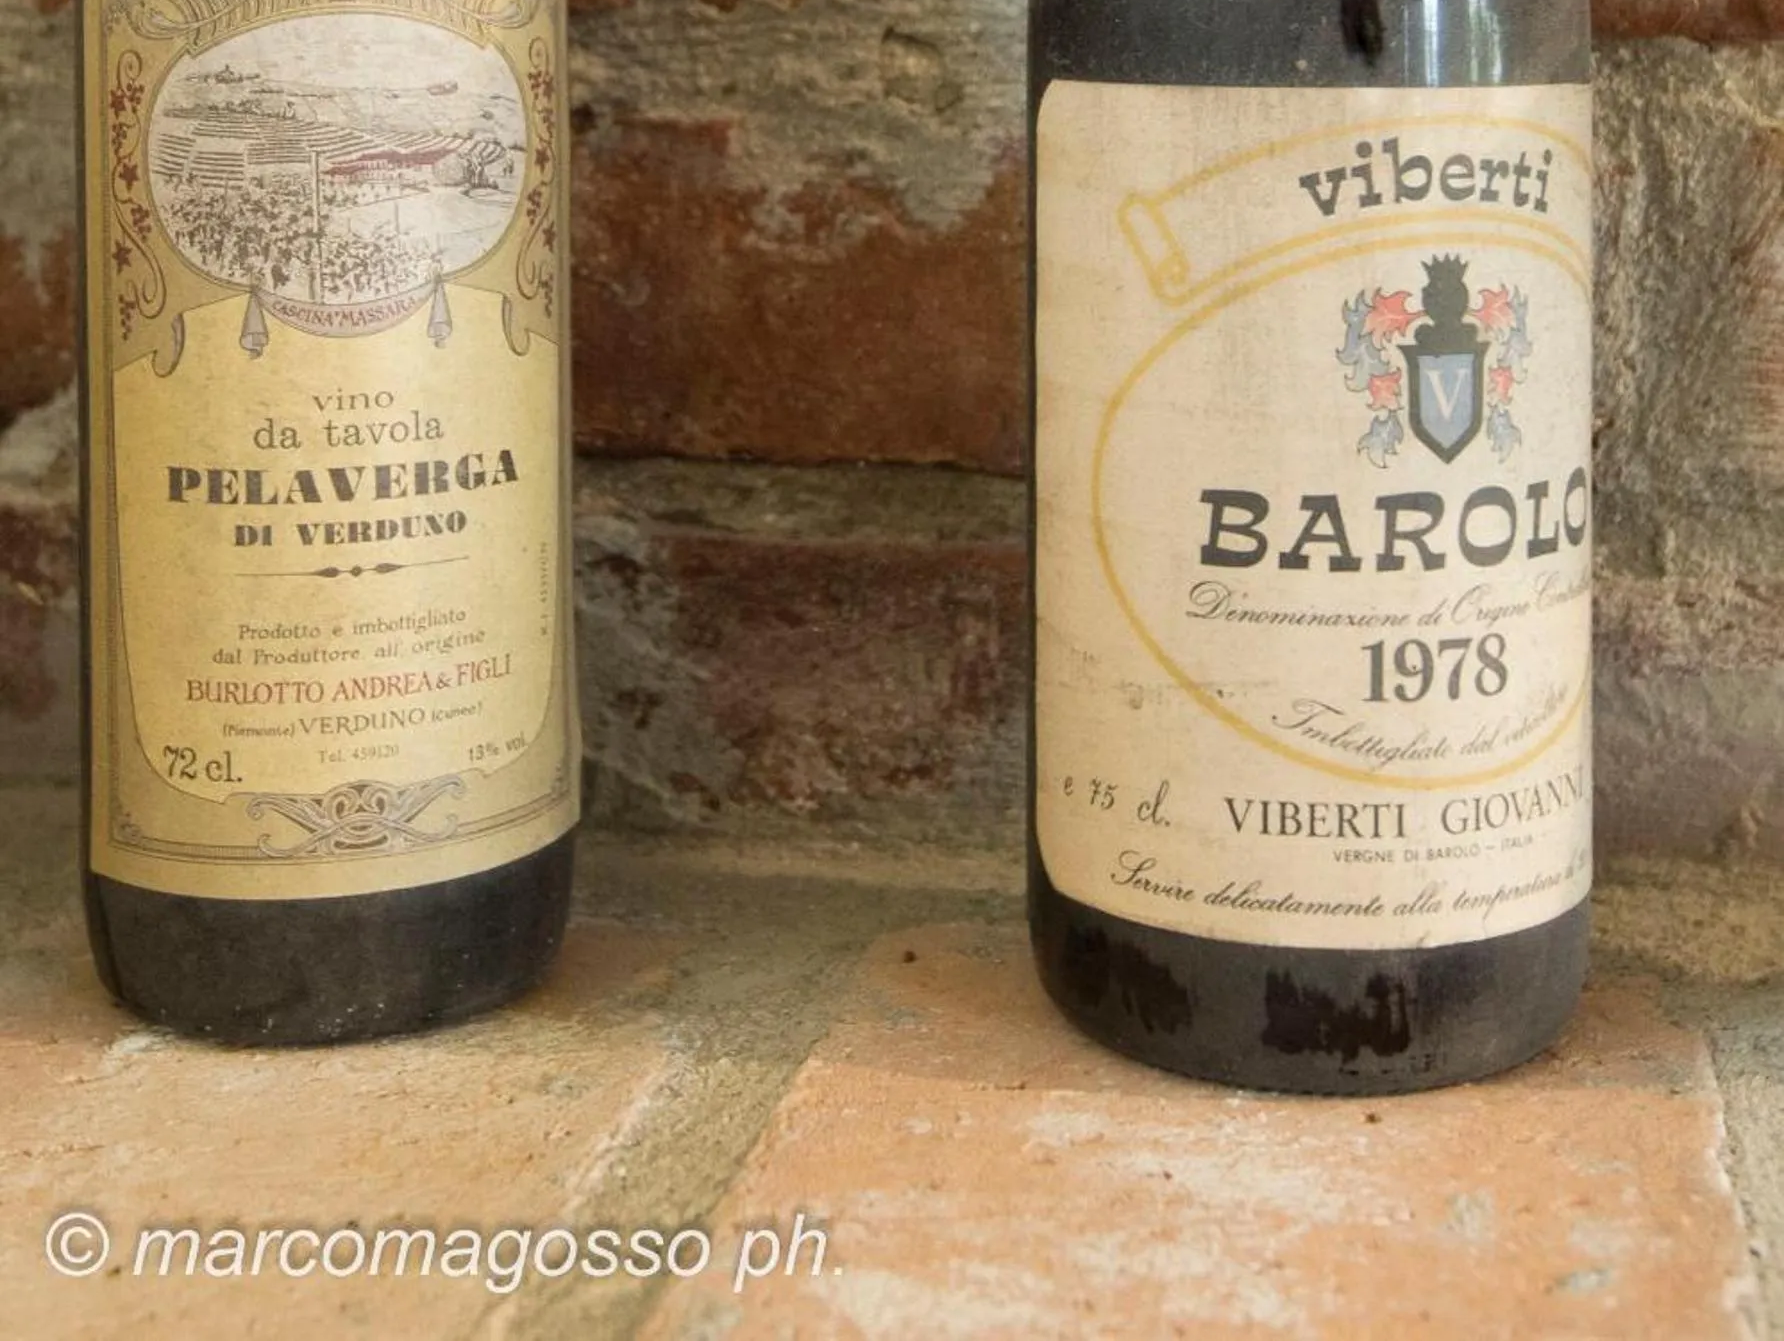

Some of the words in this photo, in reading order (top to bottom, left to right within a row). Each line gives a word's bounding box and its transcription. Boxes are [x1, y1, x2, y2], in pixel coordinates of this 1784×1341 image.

[1299, 137, 1553, 216] viberti
[312, 389, 395, 414] vino
[1425, 368, 1470, 420] V
[253, 418, 302, 451] da
[324, 411, 445, 447] tavola
[166, 449, 520, 506] PELAVERGA
[234, 524, 273, 547] DI
[296, 510, 467, 547] VERDUNO
[1199, 466, 1588, 572] BAROLO
[237, 623, 322, 640] Prodotto
[331, 626, 343, 637] e
[352, 609, 467, 635] imbottigliato
[1185, 580, 1410, 627] Denominazione
[1416, 597, 1449, 627] di
[1451, 582, 1532, 630] Origine
[213, 648, 242, 665] dal
[253, 648, 361, 665] Produttore
[411, 629, 486, 655] origine
[1360, 632, 1509, 702] 1978
[185, 678, 324, 705] BURLOTTO
[331, 670, 433, 702] ANDREA
[435, 672, 452, 690] &
[455, 653, 513, 686] FIGLI
[299, 708, 425, 736] VERDUNO
[1460, 721, 1497, 756] dal
[163, 745, 197, 780] 72
[205, 750, 243, 782] cl.
[1089, 775, 1119, 810] 75
[1137, 779, 1171, 827] cl.
[1223, 797, 1408, 839] VIBERTI
[1333, 849, 1394, 863] VERGNE
[1404, 848, 1420, 861] DI
[1427, 843, 1480, 861] BAROLO
[1110, 850, 1196, 902] Servire
[1203, 880, 1384, 917] delicatamente
[1393, 886, 1443, 917] alla
